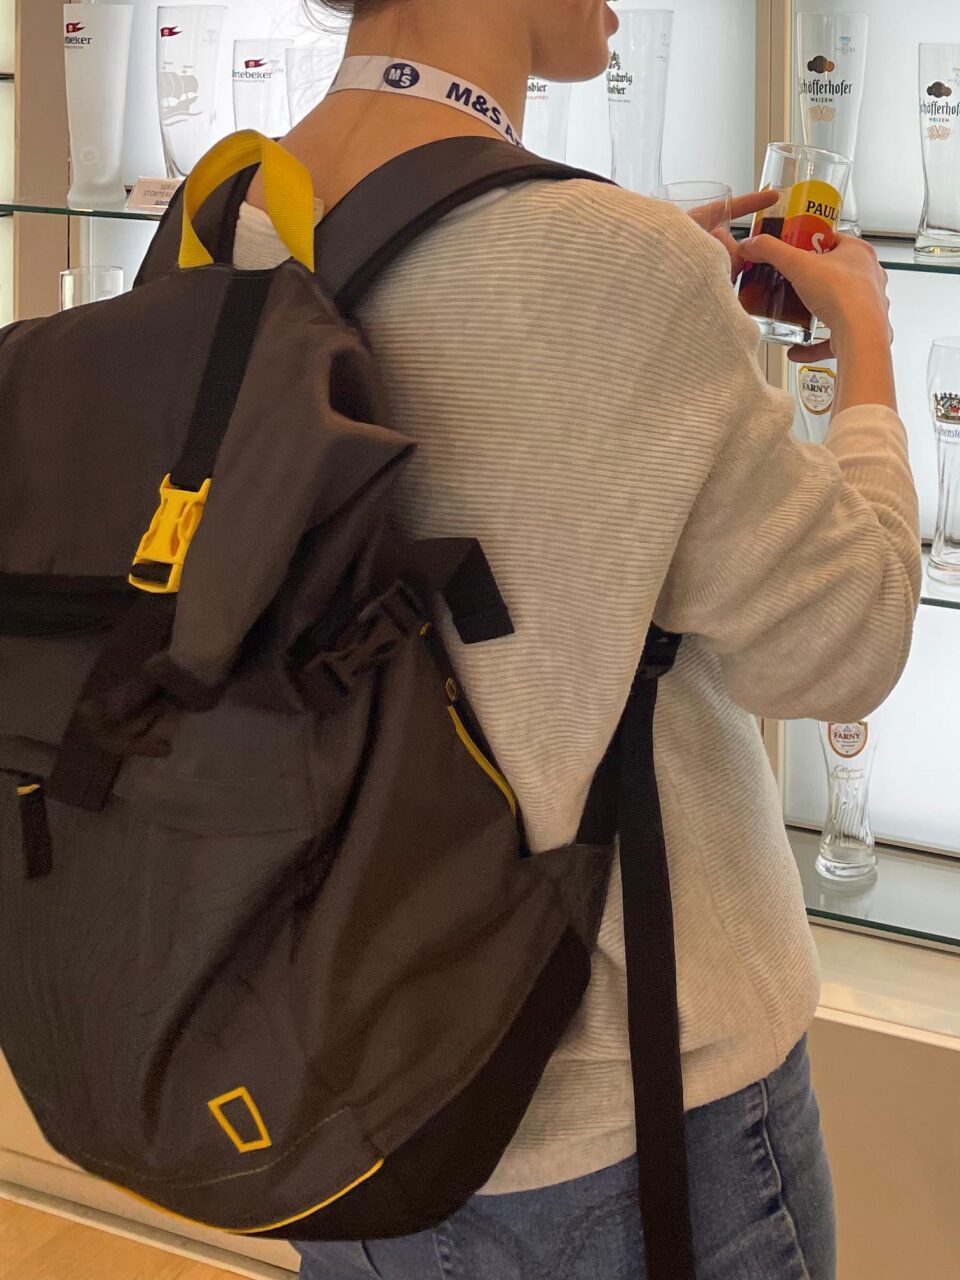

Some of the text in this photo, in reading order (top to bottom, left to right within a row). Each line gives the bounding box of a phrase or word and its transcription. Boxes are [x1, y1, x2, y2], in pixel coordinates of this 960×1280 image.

[446, 81, 502, 125] M&S
[803, 383, 830, 393] FARNY
[834, 732, 861, 740] FARNY
